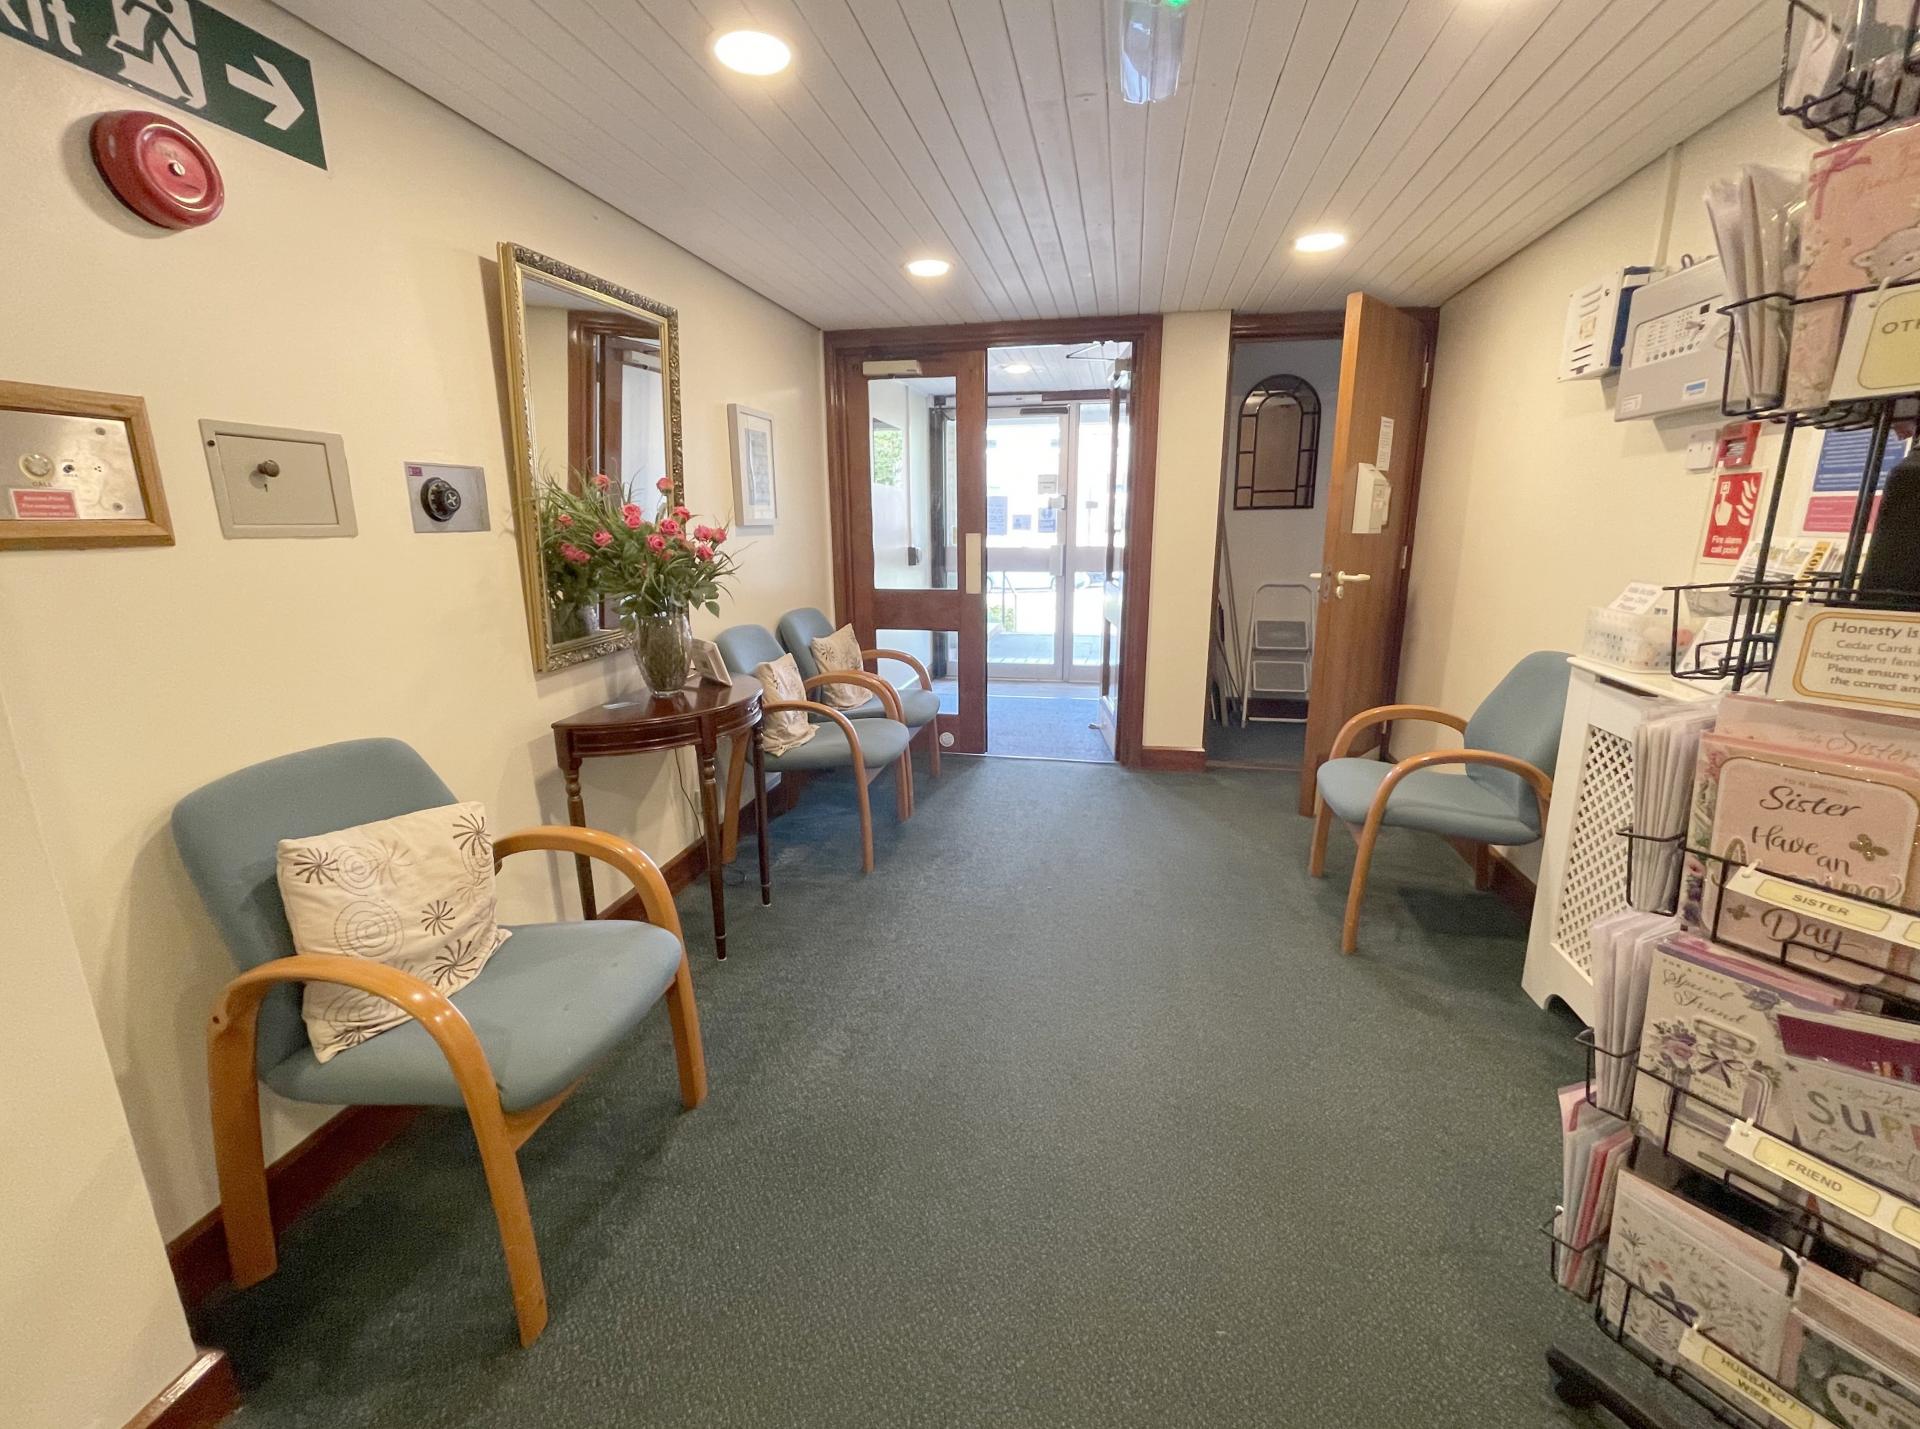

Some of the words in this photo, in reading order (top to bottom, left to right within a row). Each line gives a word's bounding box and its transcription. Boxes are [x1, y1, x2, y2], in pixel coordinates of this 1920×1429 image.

[1832, 621, 1902, 639] Honesty
[1907, 627, 1919, 638] is
[1811, 649, 1887, 666] independent
[1836, 640, 1874, 651] Cedar
[1876, 642, 1912, 655] Cards
[1827, 663, 1865, 676] Please
[1867, 669, 1910, 681] ensure
[1830, 676, 1851, 687] the
[1853, 680, 1897, 692] correct
[1826, 729, 1920, 762] Sister
[1759, 785, 1862, 818] Sister
[1752, 825, 1819, 856] Have
[1816, 854, 1852, 878] an
[1792, 894, 1850, 917] SISTER
[1761, 907, 1857, 963] Day
[1786, 1158, 1844, 1192] FRIEND
